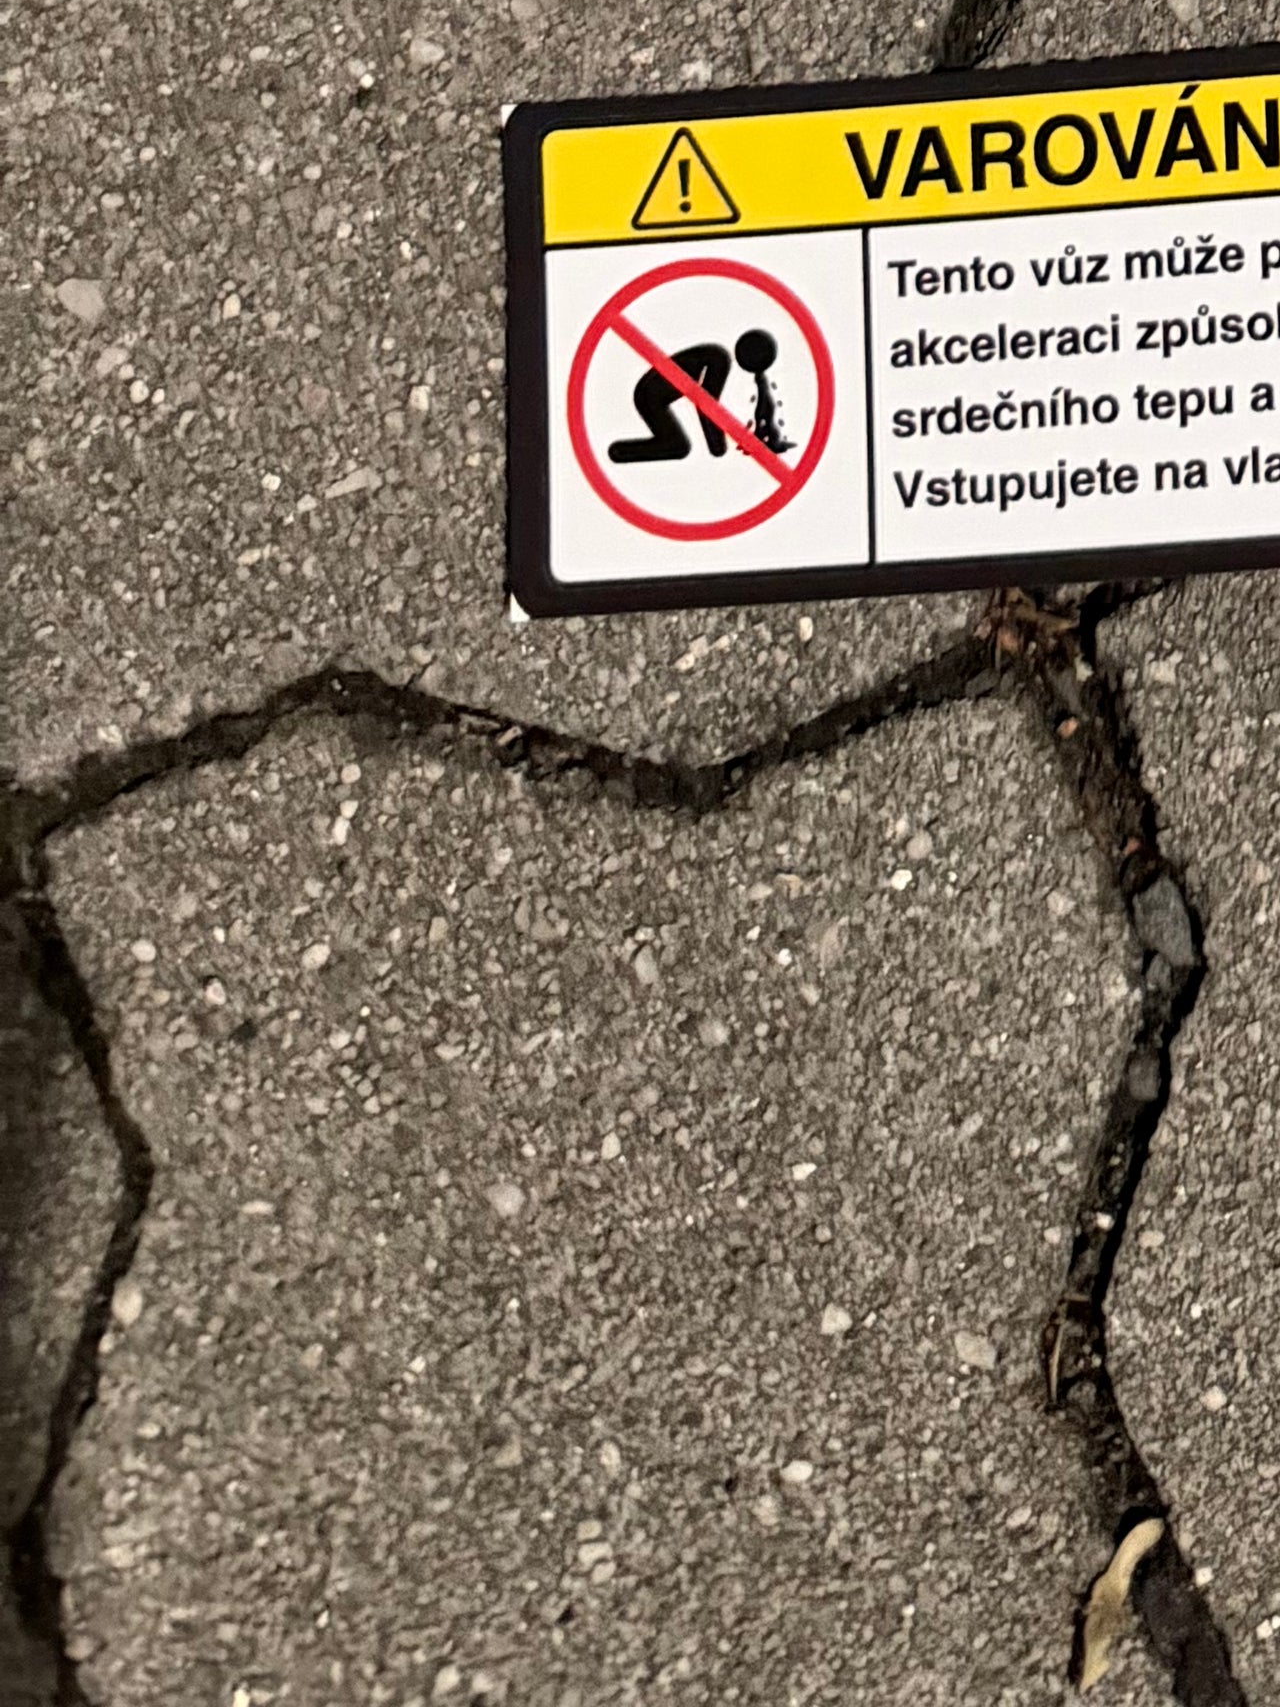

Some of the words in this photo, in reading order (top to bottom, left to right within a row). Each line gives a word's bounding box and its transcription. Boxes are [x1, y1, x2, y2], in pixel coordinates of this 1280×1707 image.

[887, 256, 1015, 298] Tento
[1029, 245, 1110, 287] vůz
[1124, 234, 1245, 281] může
[890, 313, 1120, 369] akceleraci
[892, 386, 1120, 439] srdečního
[1133, 384, 1234, 428] tepu
[1250, 382, 1275, 413] a
[893, 458, 1139, 513] Vstupujete
[1154, 459, 1209, 491] na
